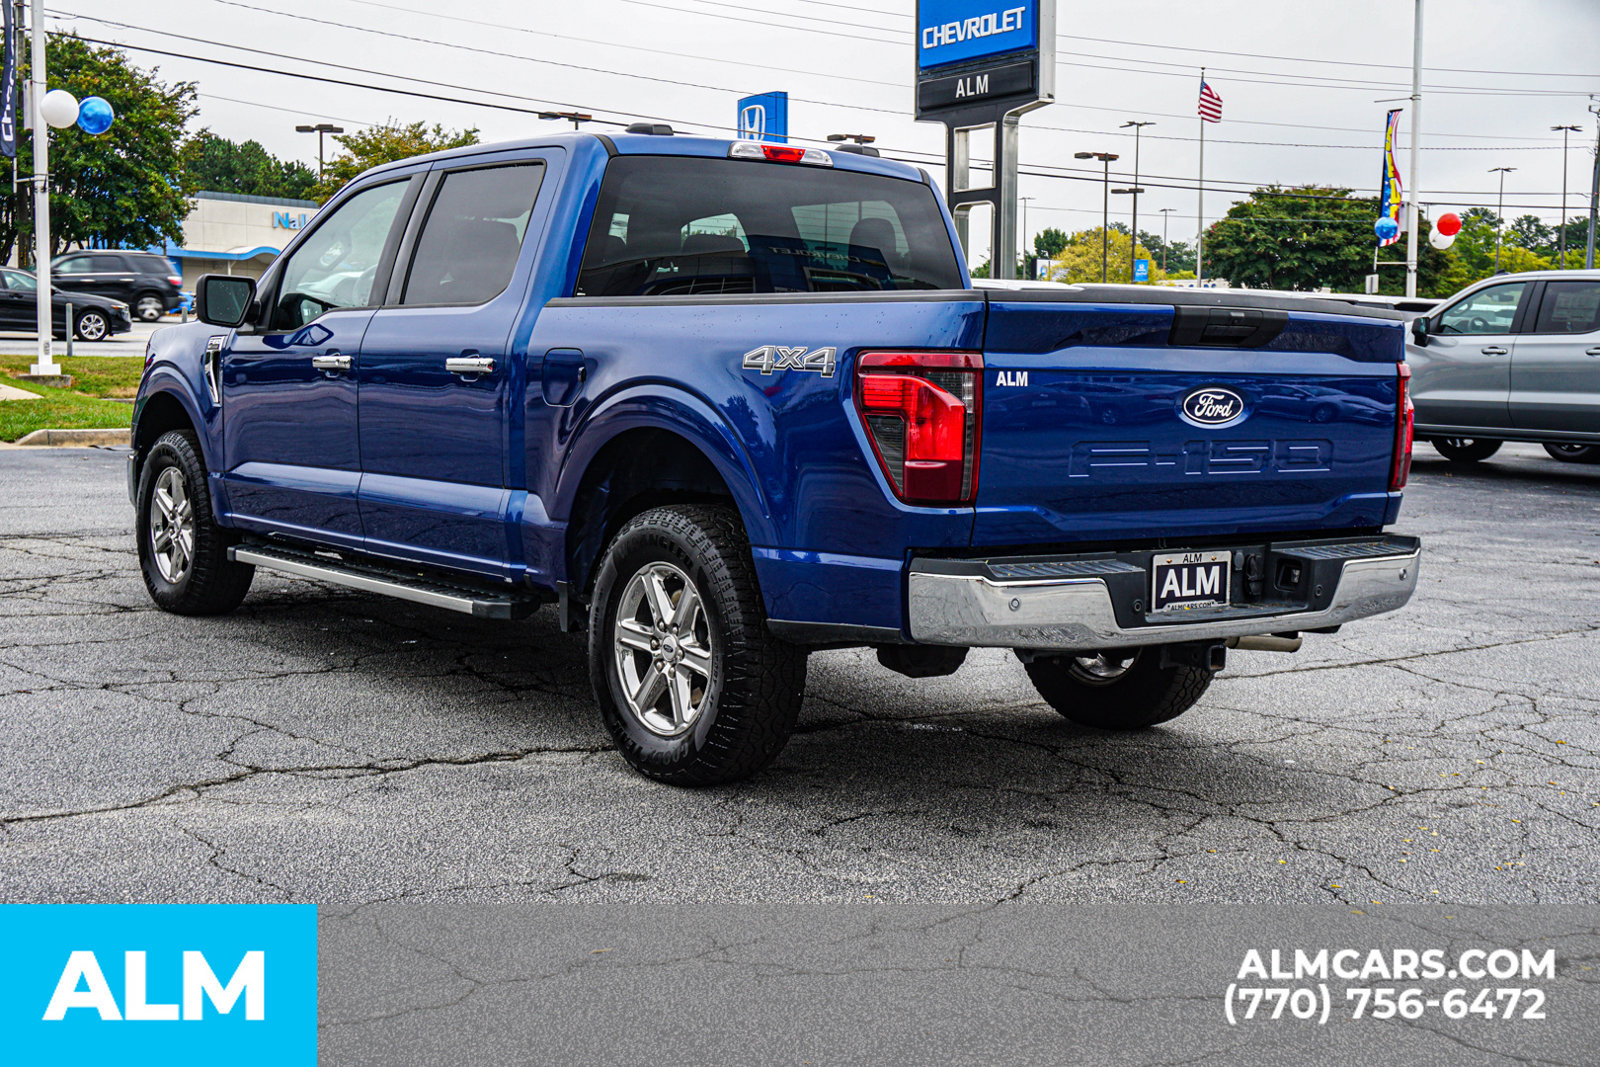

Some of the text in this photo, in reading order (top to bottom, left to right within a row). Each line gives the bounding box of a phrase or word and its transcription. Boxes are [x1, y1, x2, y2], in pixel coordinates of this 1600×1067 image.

[922, 6, 1026, 49] CHEVROLET
[955, 74, 989, 98] ALM
[996, 371, 1028, 387] ALM
[1194, 392, 1234, 418] Ford
[1068, 439, 1334, 477] F-150
[1182, 553, 1202, 563] ALM
[1160, 566, 1220, 598] ALM
